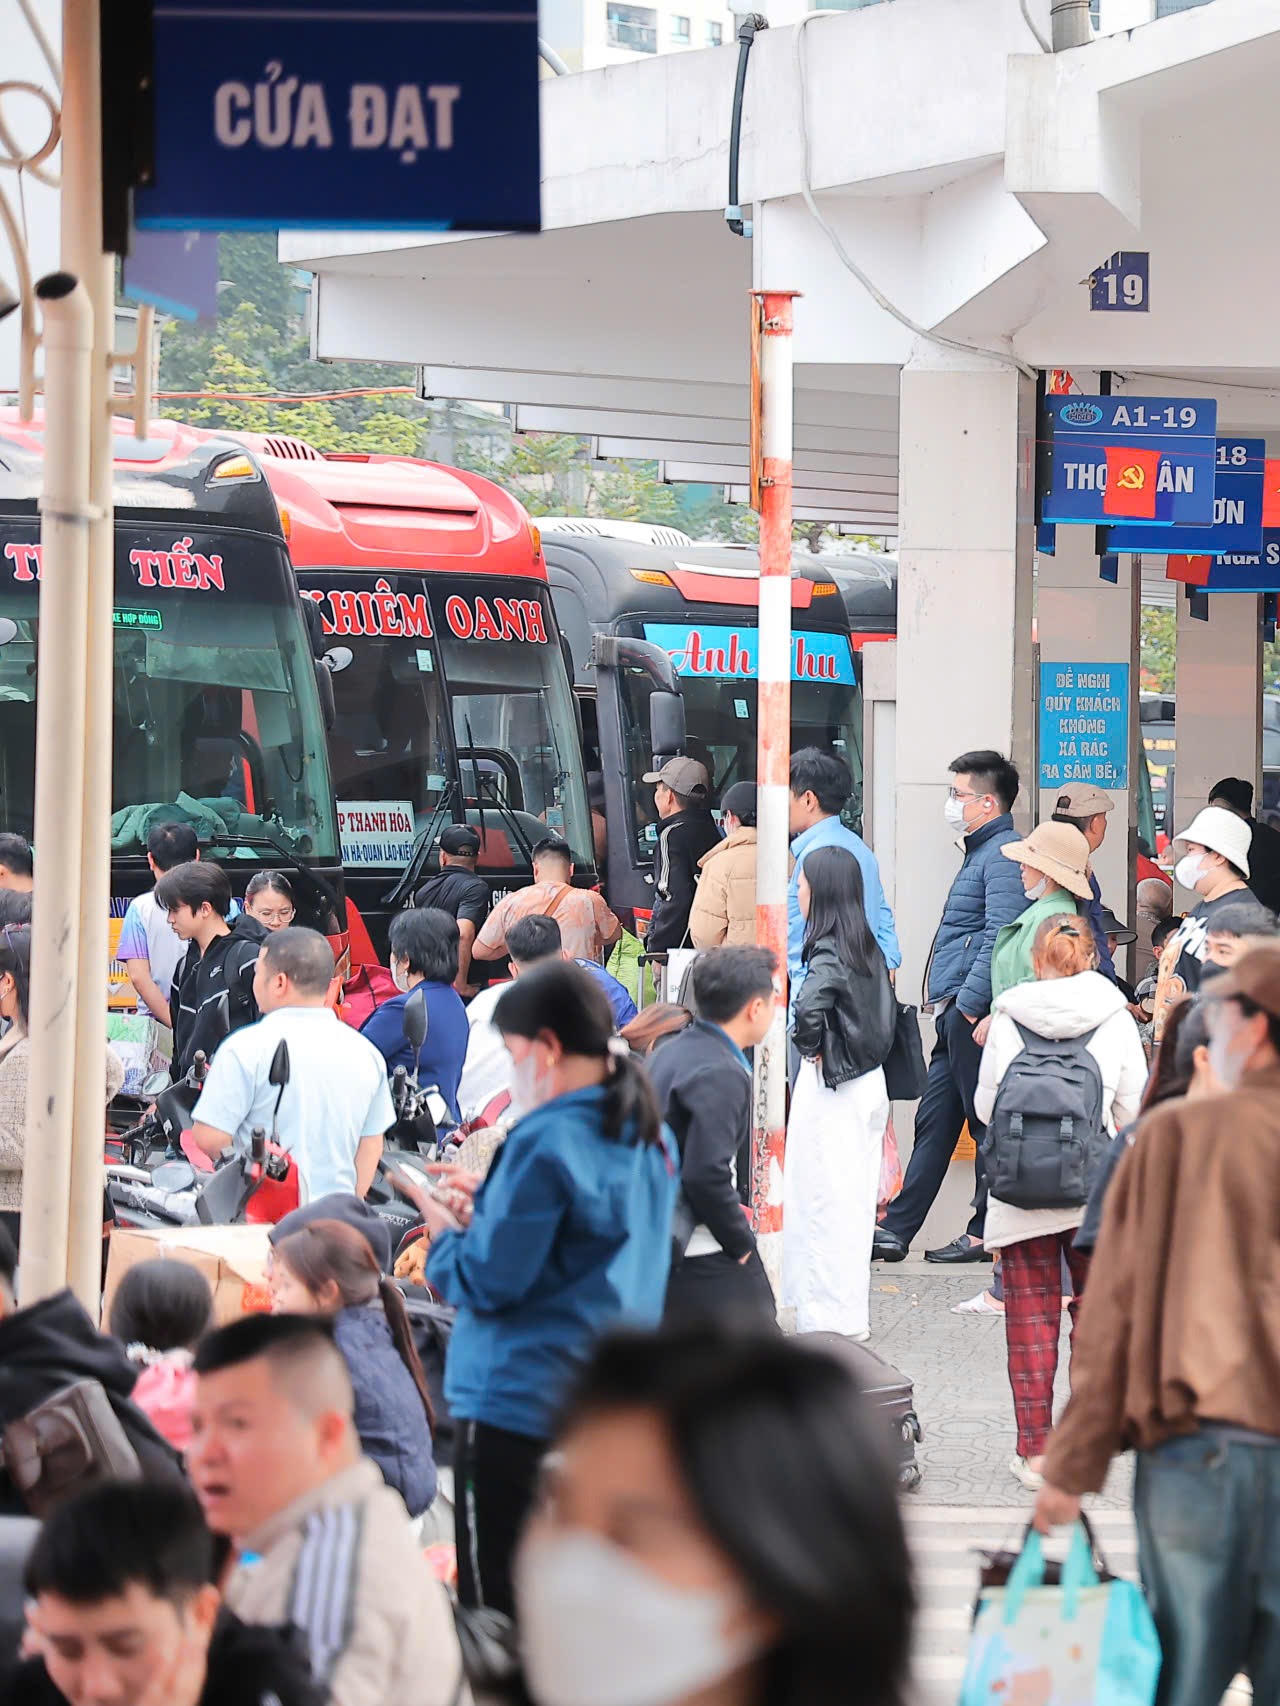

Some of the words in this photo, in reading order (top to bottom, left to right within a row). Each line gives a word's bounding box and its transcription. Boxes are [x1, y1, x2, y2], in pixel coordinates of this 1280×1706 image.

[214, 60, 332, 149] CỬA
[348, 82, 461, 164] ĐẠT
[1103, 273, 1143, 306] 19
[1111, 405, 1197, 429] A1-19
[1063, 463, 1108, 497] THỌ
[128, 536, 226, 592] TIẾN
[446, 594, 548, 644] OANH
[668, 630, 757, 676] Anh
[795, 636, 841, 679] hu
[1056, 666, 1074, 689] ĐỀ
[1077, 673, 1111, 692] NGHỊ
[1076, 692, 1121, 712] KHÁCH
[1060, 714, 1106, 734] KHÔNG
[1058, 736, 1078, 756] XẢ
[1080, 738, 1108, 757] RÁC
[1064, 760, 1092, 779] SÂN
[347, 812, 388, 833] THANH
